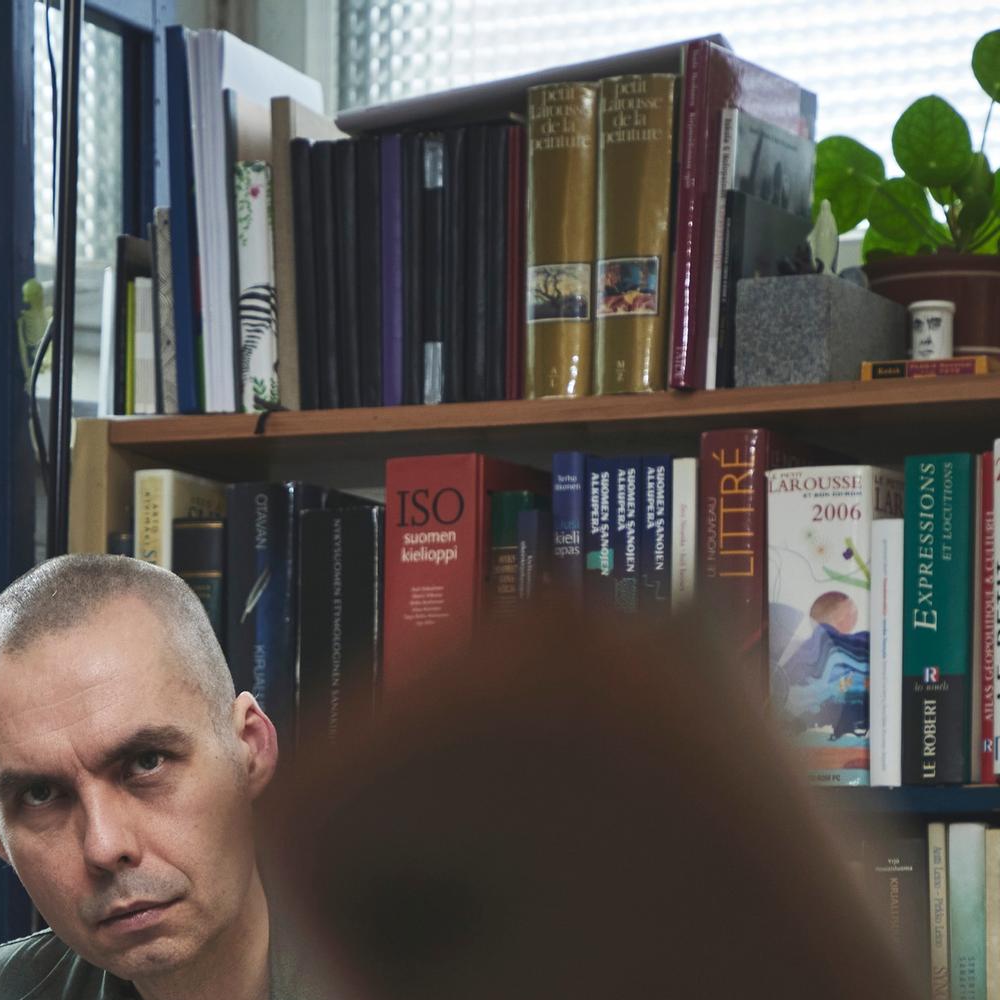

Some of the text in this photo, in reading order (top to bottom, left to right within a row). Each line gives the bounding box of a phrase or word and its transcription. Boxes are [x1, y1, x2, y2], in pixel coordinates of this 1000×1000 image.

[255, 493, 269, 550] OTAVAN
[397, 487, 465, 528] ISO
[600, 471, 610, 576] SUOMEN SANOJEN
[625, 468, 636, 573] SUOMEN SANOJEN
[655, 465, 665, 571] SUOMEN SANOJEN
[713, 447, 756, 578] LITTRÉ
[768, 475, 863, 494] LAROUSSE
[812, 503, 862, 522] 2006
[942, 461, 953, 561] ET LOCUTIONS
[333, 518, 342, 597] NYKYSUOMEN
[401, 545, 458, 566] kielioppi
[403, 530, 457, 546] suomen
[555, 530, 580, 546] kieli
[913, 462, 937, 632] EXPRESSIONS
[331, 598, 342, 687] ETYMOLOGINEN
[923, 699, 937, 778] LE ROBERT
[984, 684, 994, 721] ATLAS
